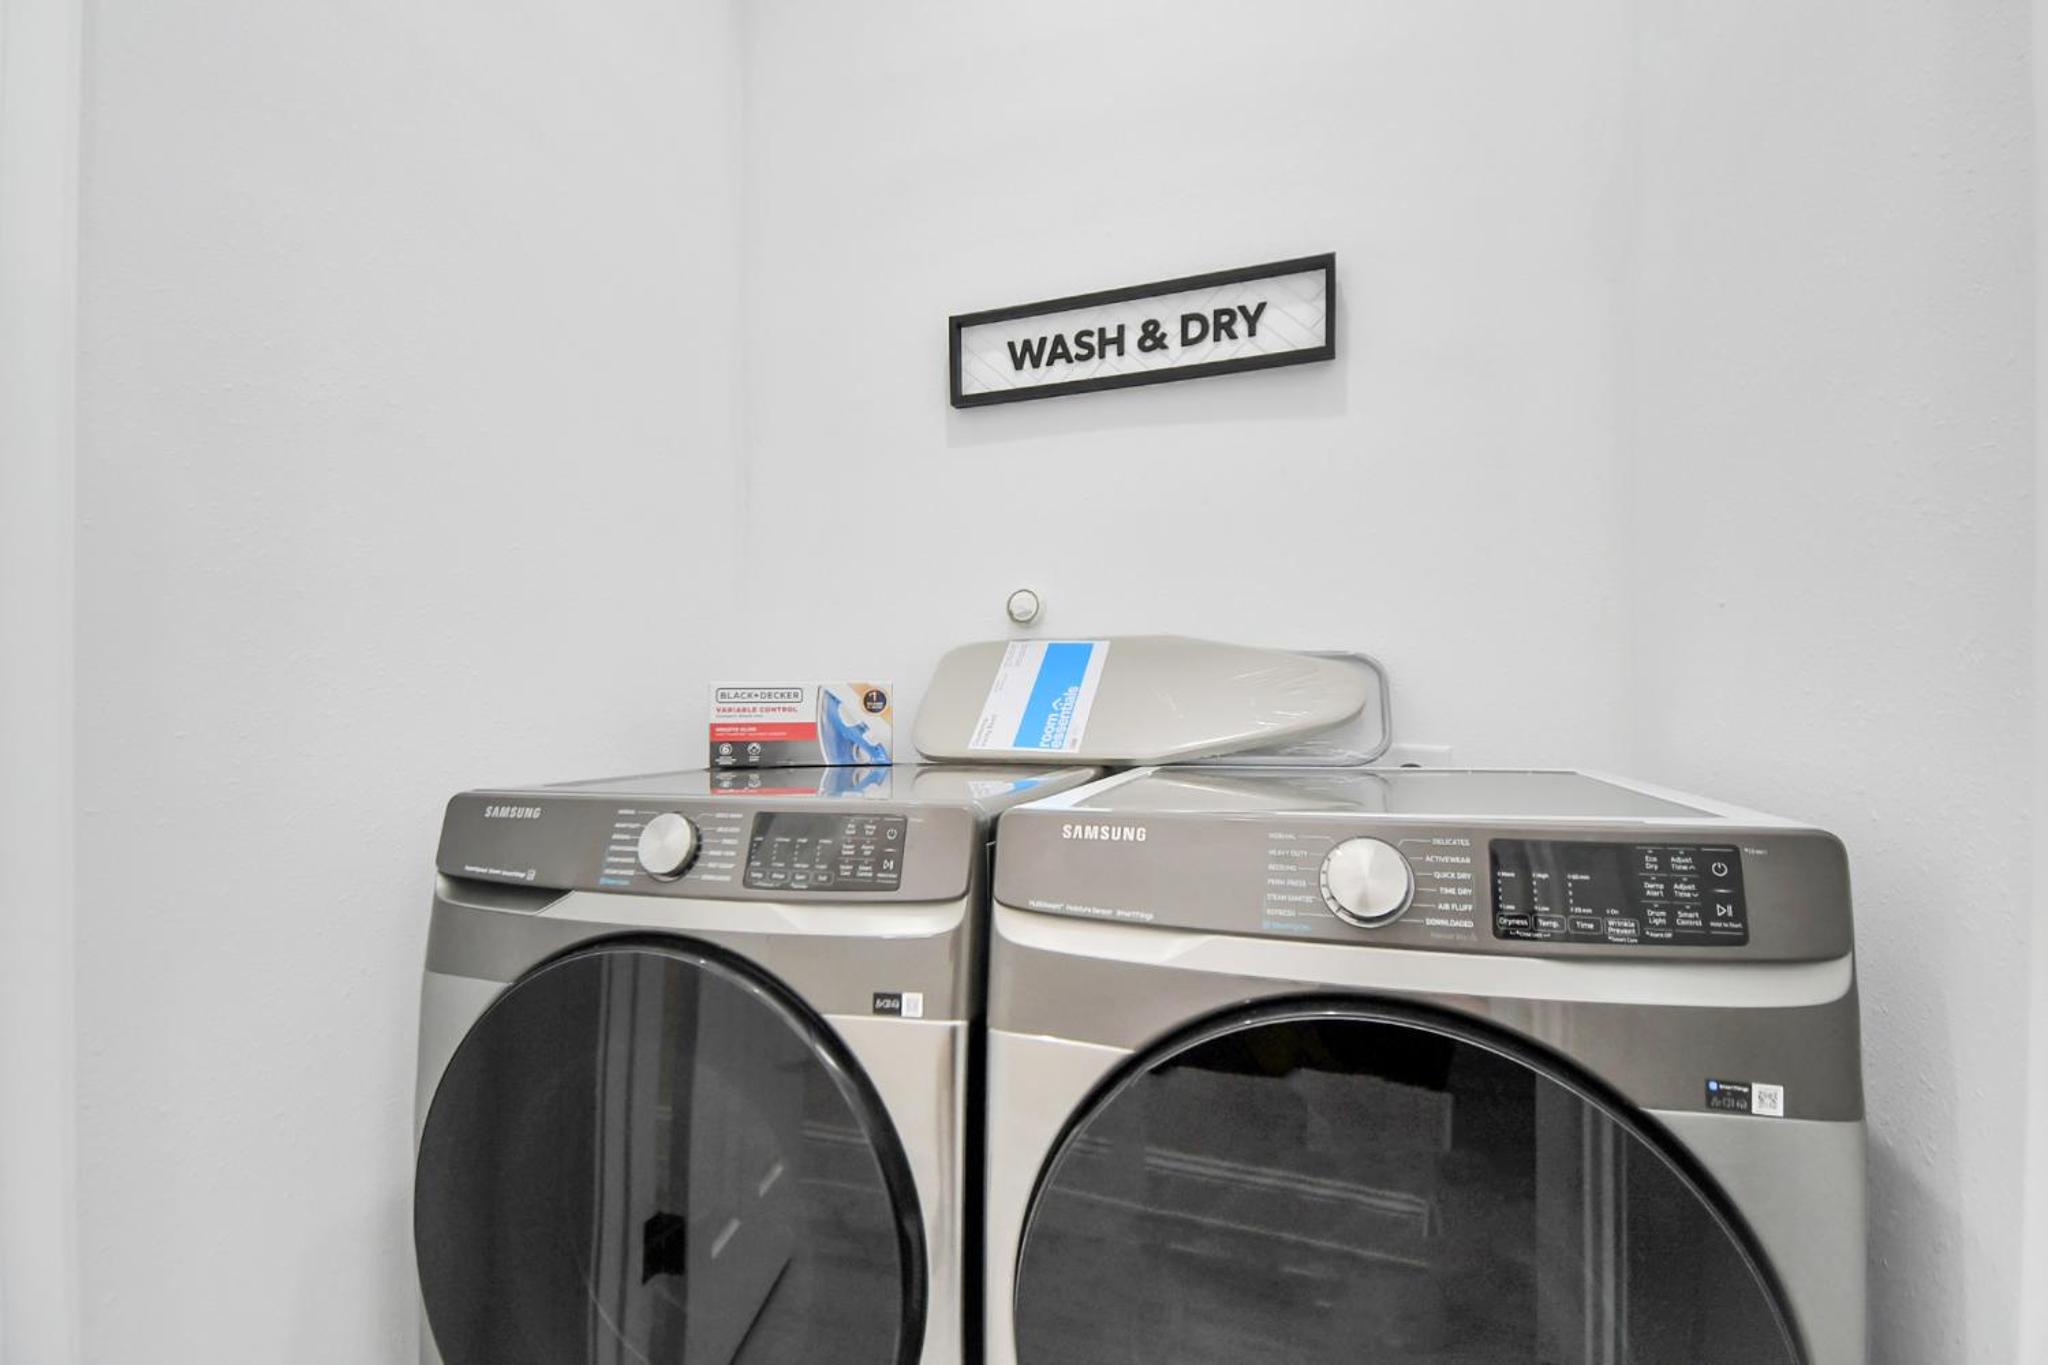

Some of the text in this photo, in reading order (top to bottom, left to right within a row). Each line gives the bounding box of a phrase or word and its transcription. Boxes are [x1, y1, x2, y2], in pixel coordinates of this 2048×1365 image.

[1007, 302, 1267, 371] WASH & DRY
[719, 691, 800, 700] BLACK+DECKER
[1051, 685, 1079, 749] essentials
[1039, 713, 1061, 748] room
[484, 806, 542, 819] SAMSUNG
[1062, 824, 1147, 842] SAMSUNG
[1425, 855, 1472, 864] ACTIVEWEAR
[1433, 871, 1472, 880] QUICK DRY
[1440, 886, 1472, 896] TIME DRY
[1438, 902, 1473, 912] AIR FLUFF
[1425, 918, 1474, 928] DOWNLOADED
